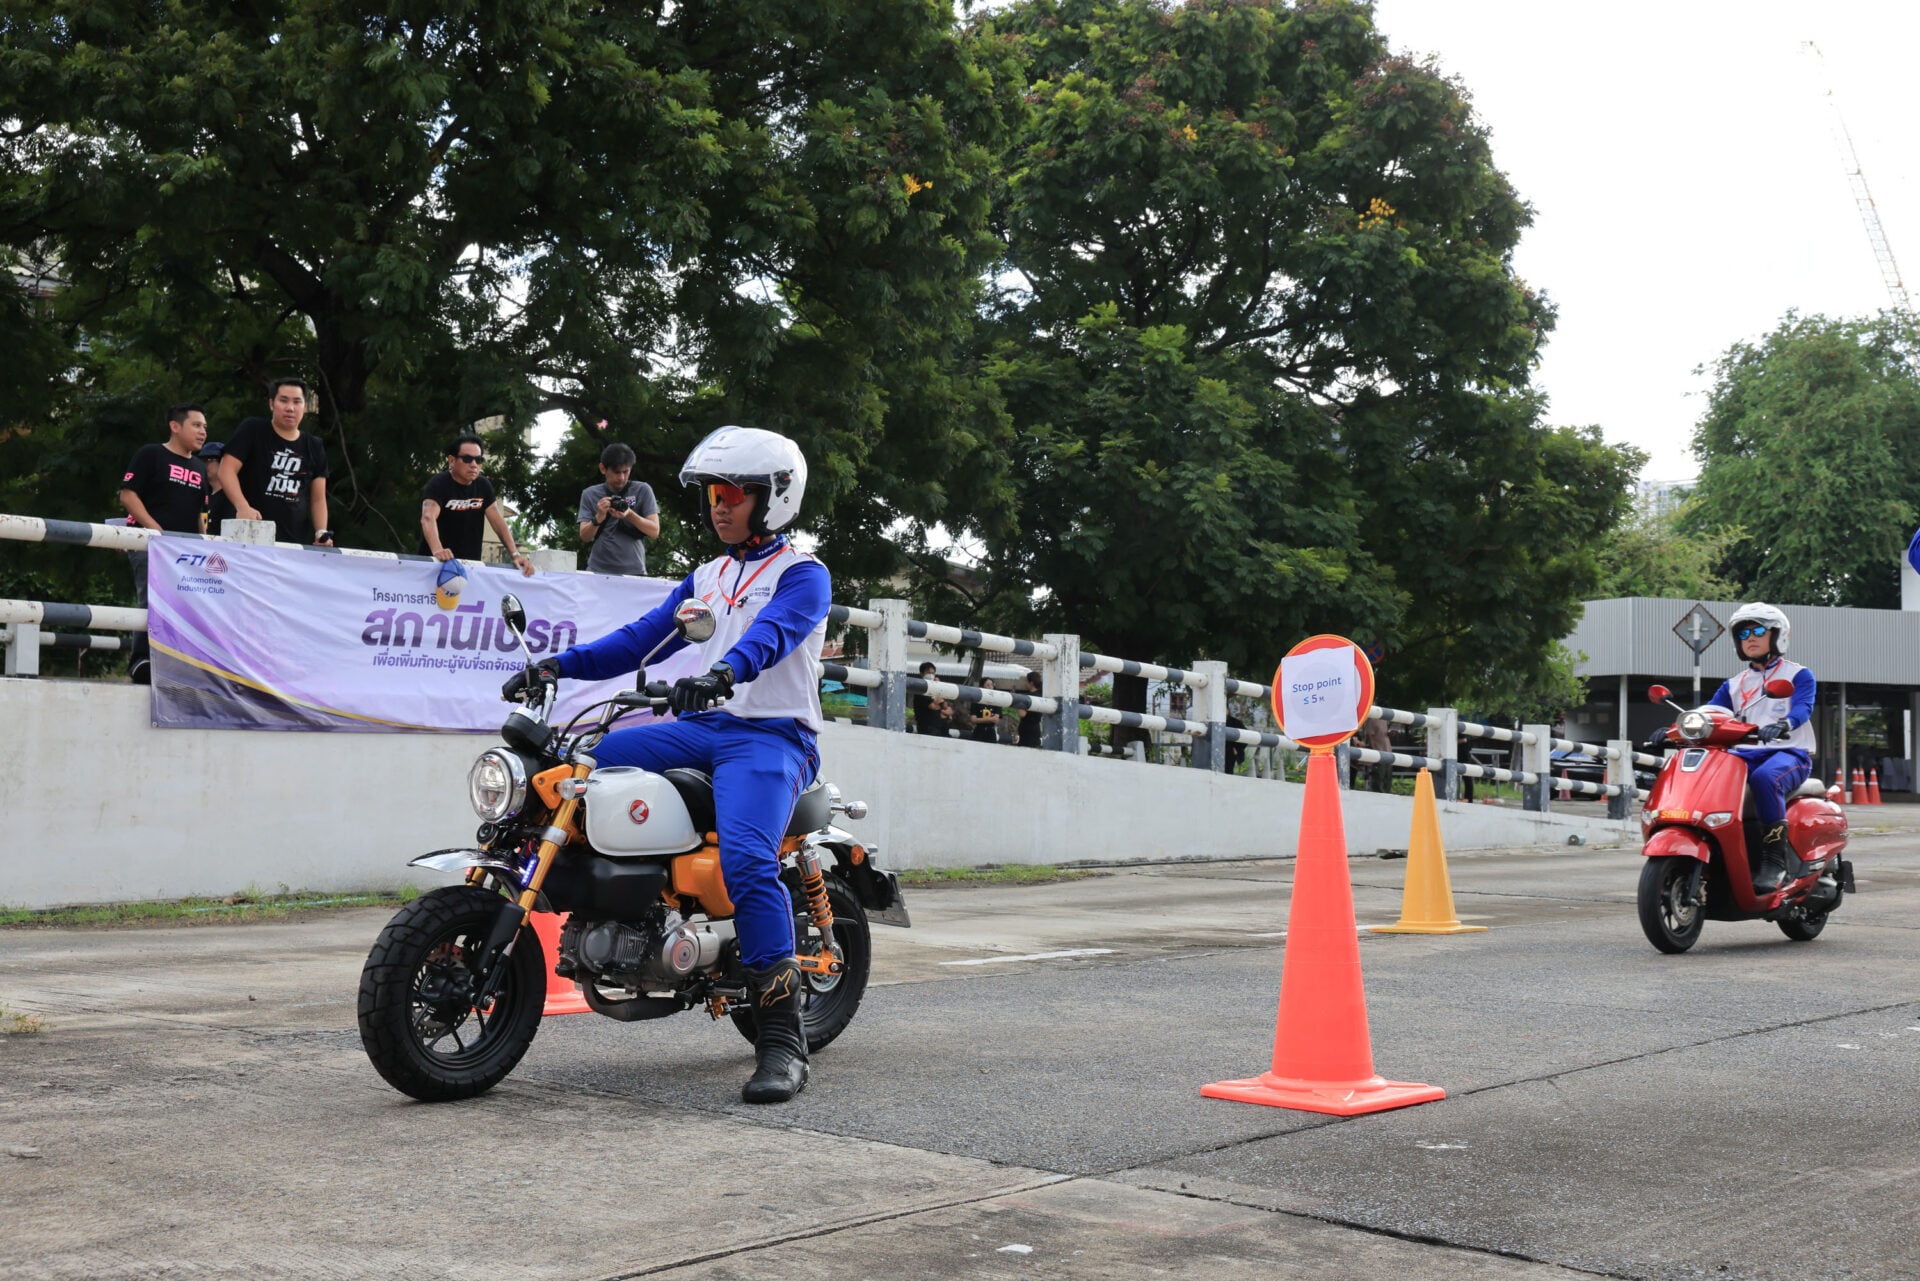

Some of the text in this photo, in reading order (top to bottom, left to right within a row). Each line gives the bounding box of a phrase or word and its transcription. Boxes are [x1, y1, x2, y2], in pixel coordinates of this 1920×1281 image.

[168, 464, 202, 486] BIG
[176, 554, 207, 566] FTI
[181, 576, 223, 585] Automotive
[177, 584, 225, 595] Industry Club
[372, 587, 438, 605] โครงการสาธิ
[372, 648, 525, 674] เพื่อเพิ่มทักษะผู้ขับขี่รถจักรย
[1292, 677, 1342, 693] Stop point
